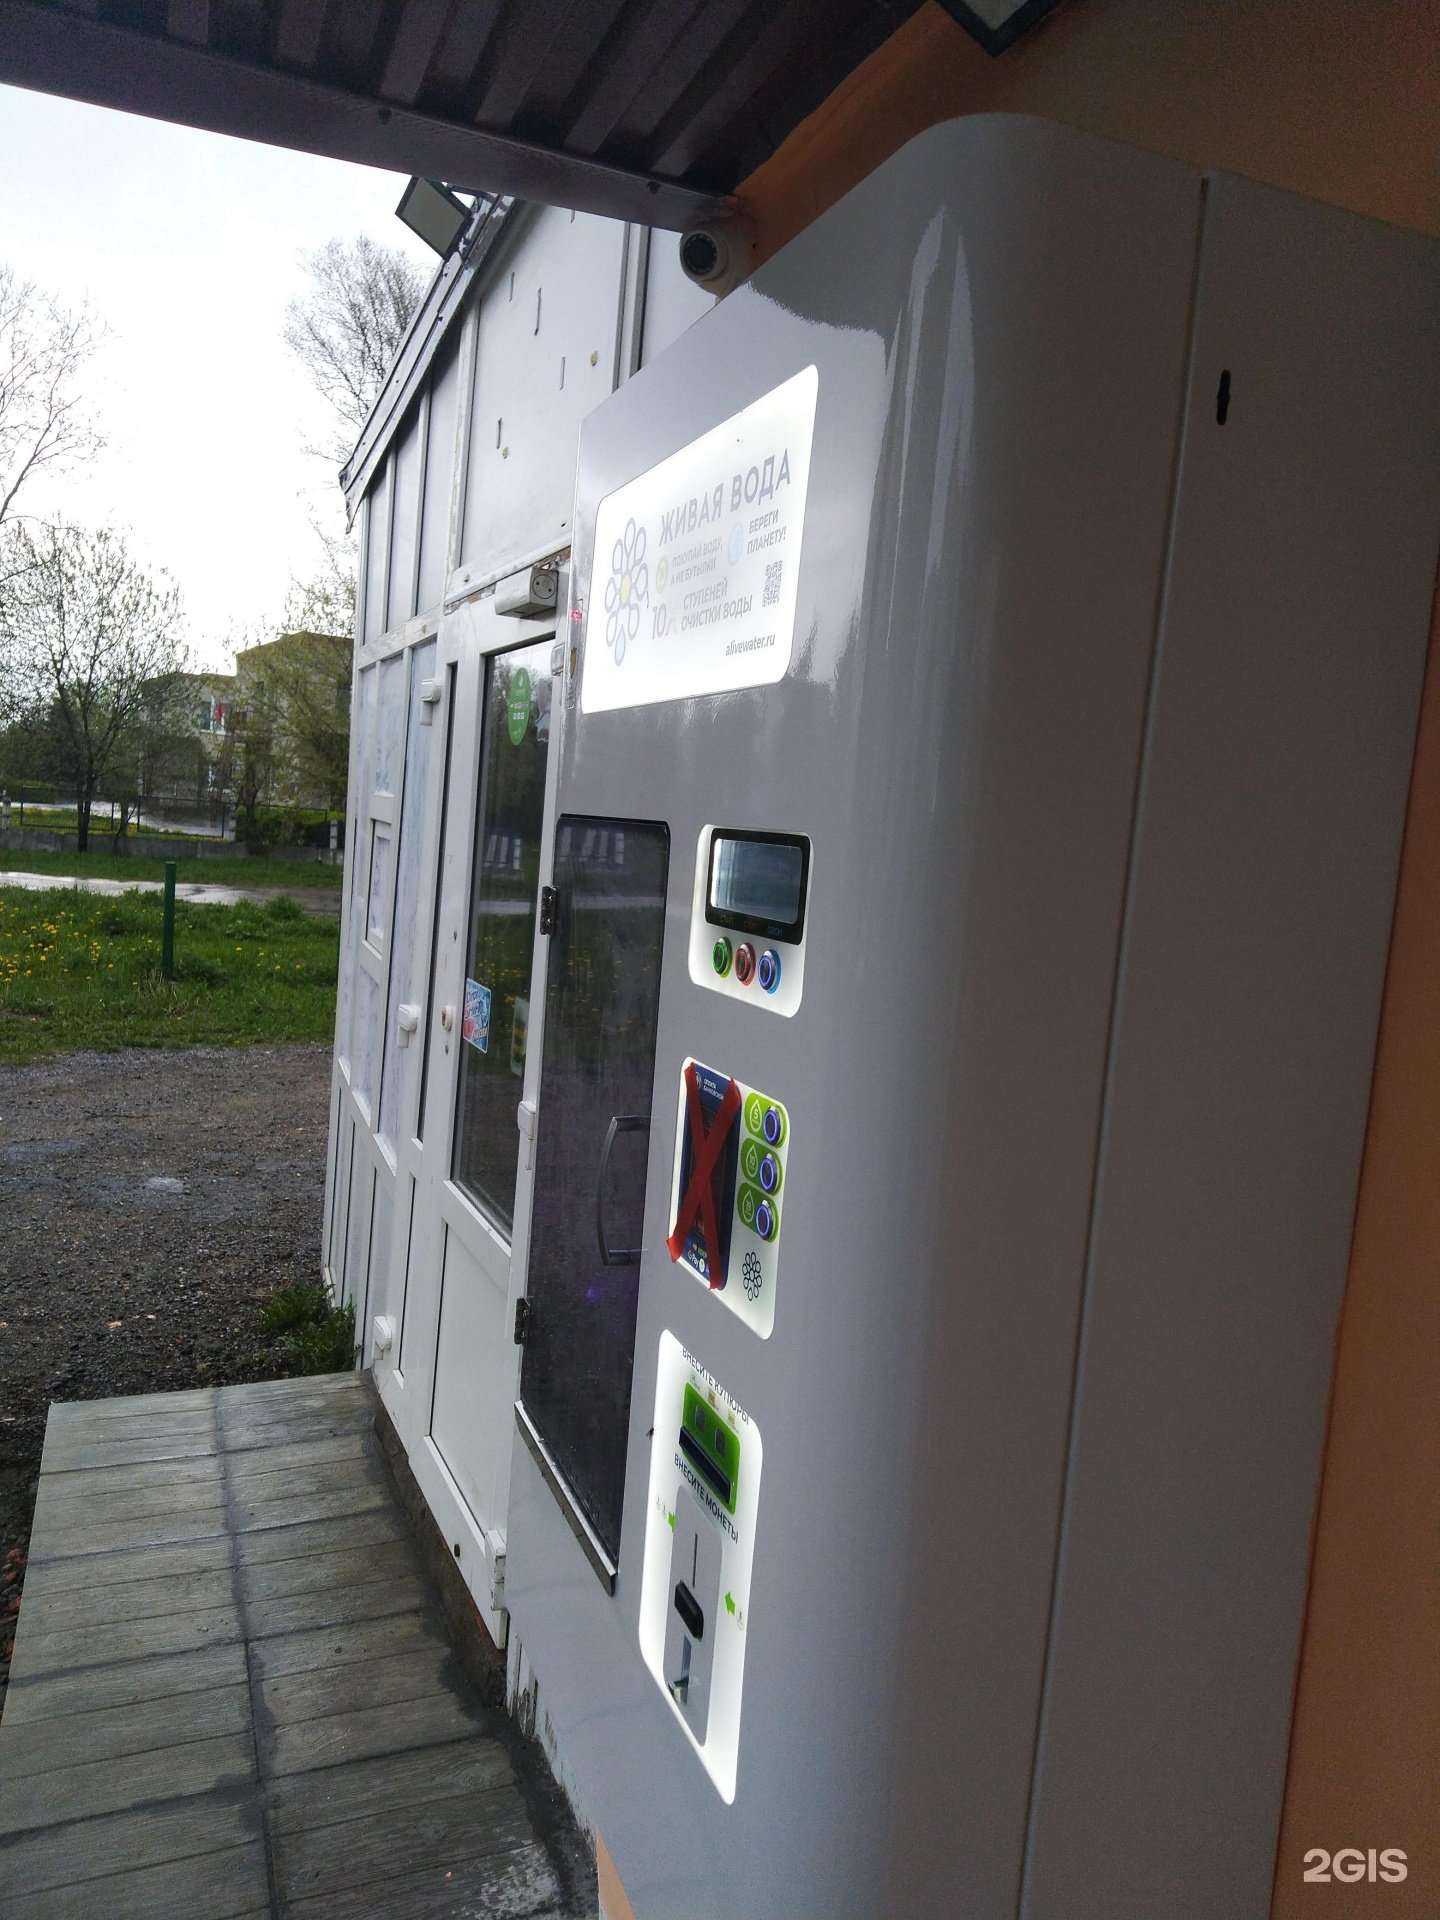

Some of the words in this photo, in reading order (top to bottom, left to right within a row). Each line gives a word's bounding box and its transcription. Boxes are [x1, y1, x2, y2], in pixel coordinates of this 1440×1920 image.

[659, 483, 724, 547] ЖИВАЯ
[730, 448, 790, 512] ВОДА
[749, 508, 779, 534] БЕРЕГИ
[747, 526, 787, 554] ПЛАНЕТУ!
[683, 576, 728, 610] СТУПЕНЕЙ
[681, 603, 721, 631] ОЧИСТКИ
[723, 594, 752, 620] ВОДЫ
[725, 633, 776, 656] alivewater.ru
[674, 1454, 705, 1500] ВНЕСИТЕ
[705, 1493, 740, 1544] МОНЕТЫ
